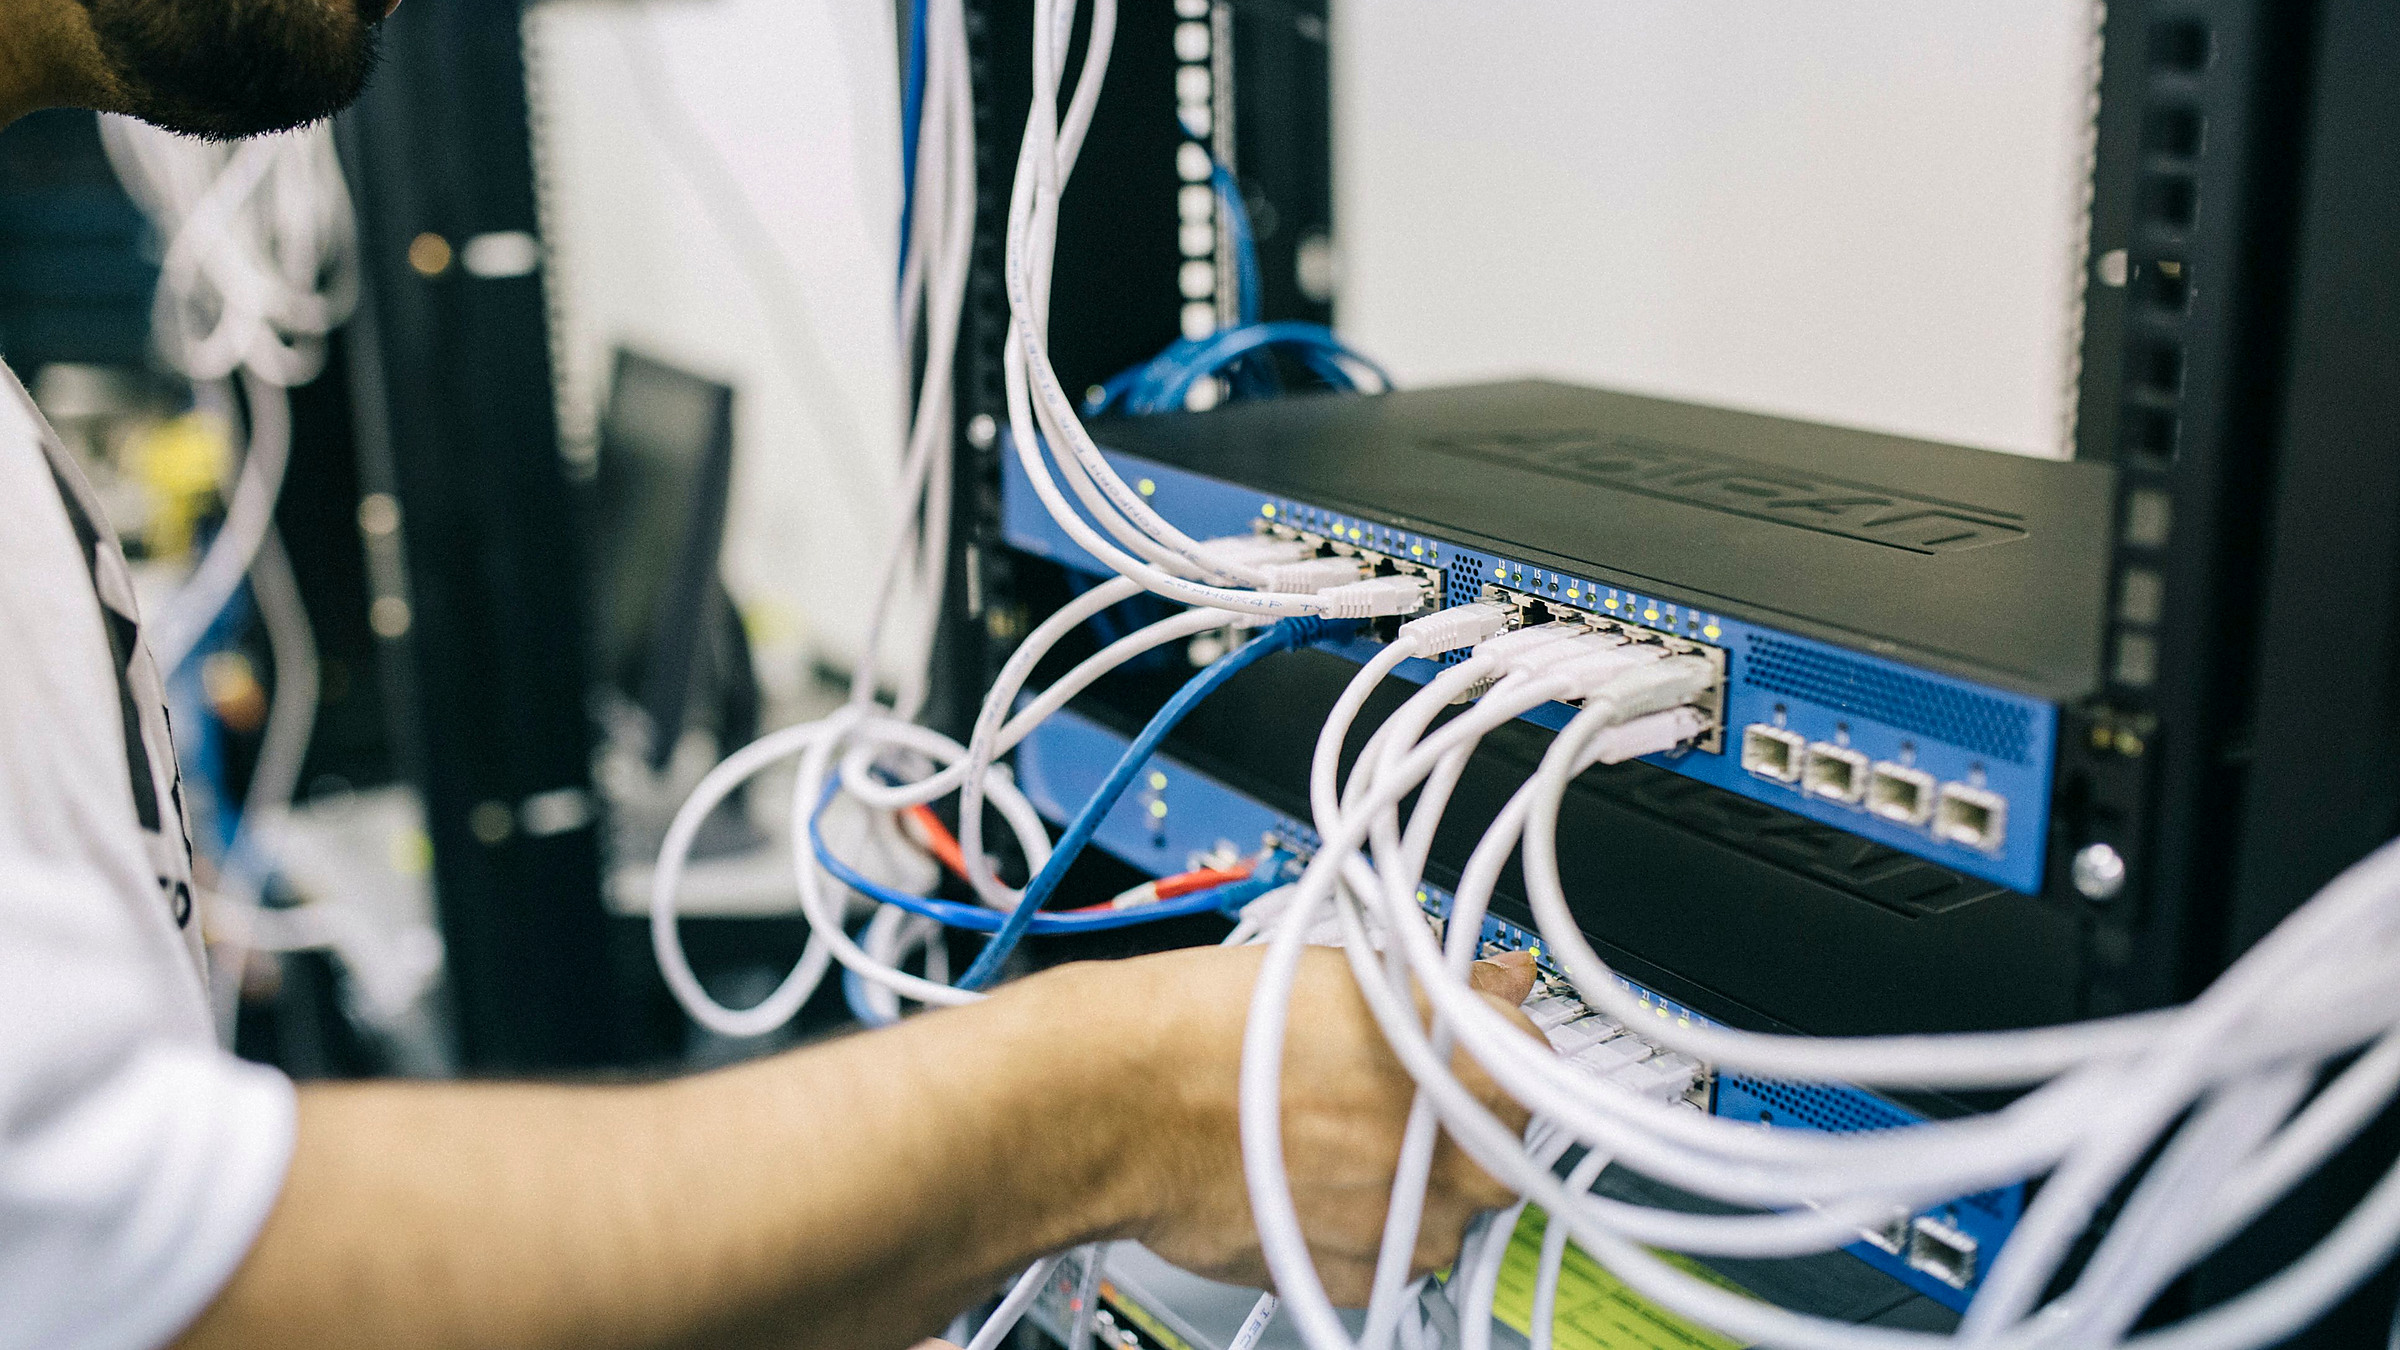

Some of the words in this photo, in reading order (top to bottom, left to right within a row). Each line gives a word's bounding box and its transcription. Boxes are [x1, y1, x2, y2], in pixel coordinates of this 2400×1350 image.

[1498, 559, 1506, 570] 13
[1514, 563, 1522, 574] 14
[1534, 568, 1542, 579] 15
[1551, 573, 1559, 584] 16
[1571, 578, 1579, 589] 17
